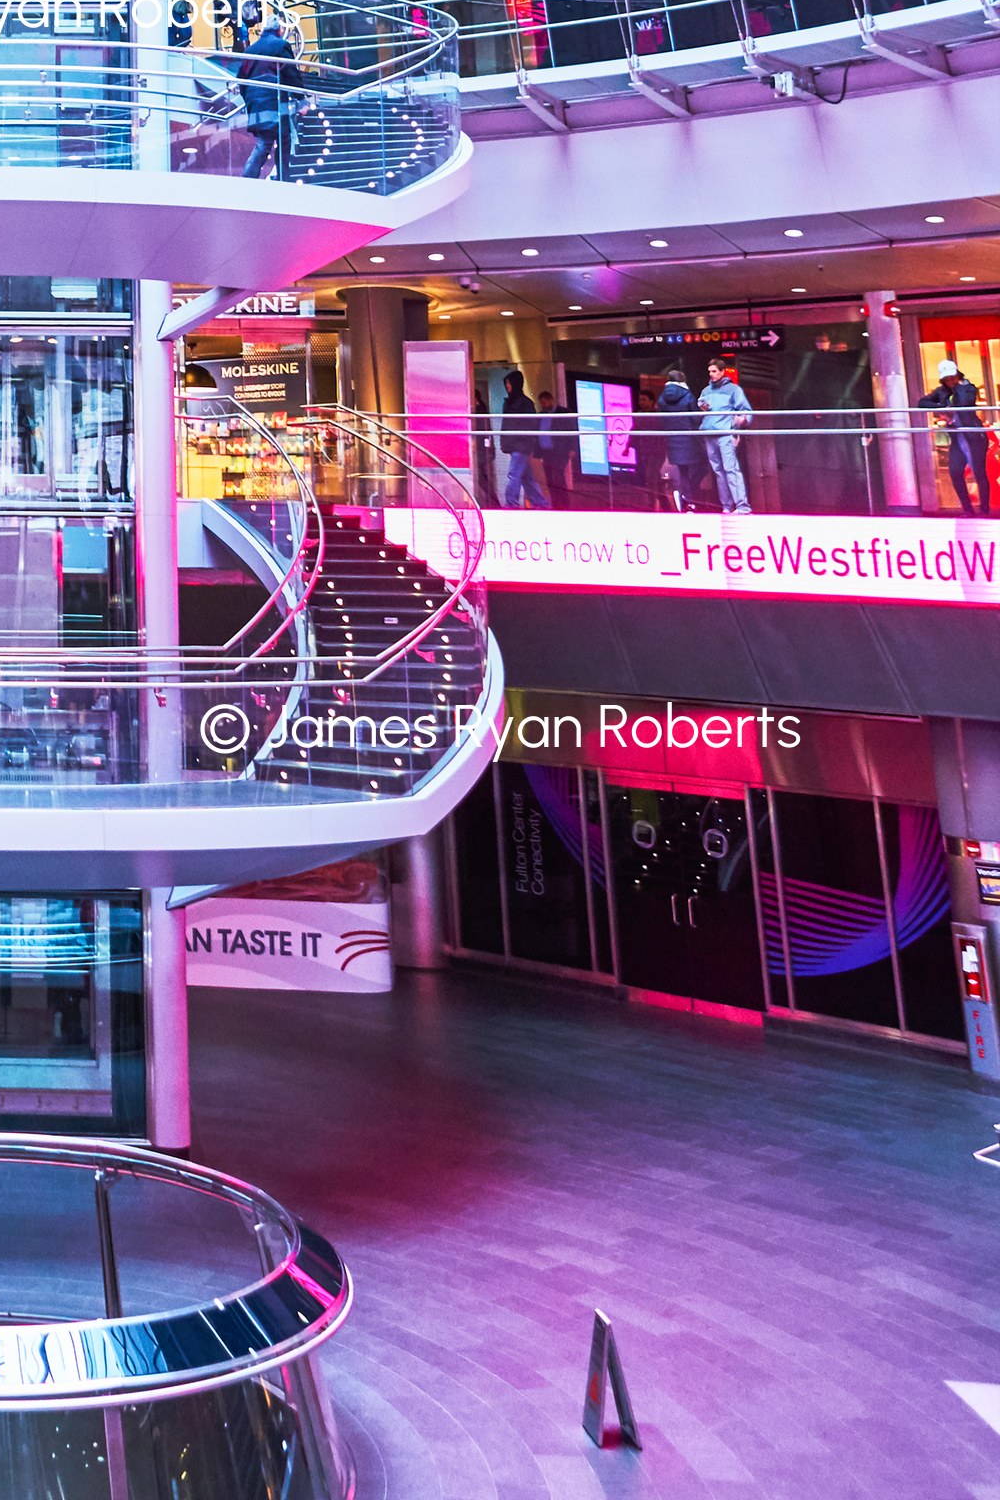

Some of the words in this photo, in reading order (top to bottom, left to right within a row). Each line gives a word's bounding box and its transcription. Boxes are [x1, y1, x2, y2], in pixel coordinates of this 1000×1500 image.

[221, 363, 299, 378] MOLESKINE
[564, 543, 614, 563] now
[624, 539, 650, 565] to
[512, 792, 526, 842] Center
[515, 845, 529, 893] Fulton
[217, 928, 293, 957] TASTE
[301, 932, 323, 958] IT
[973, 1009, 985, 1059] FIRE
